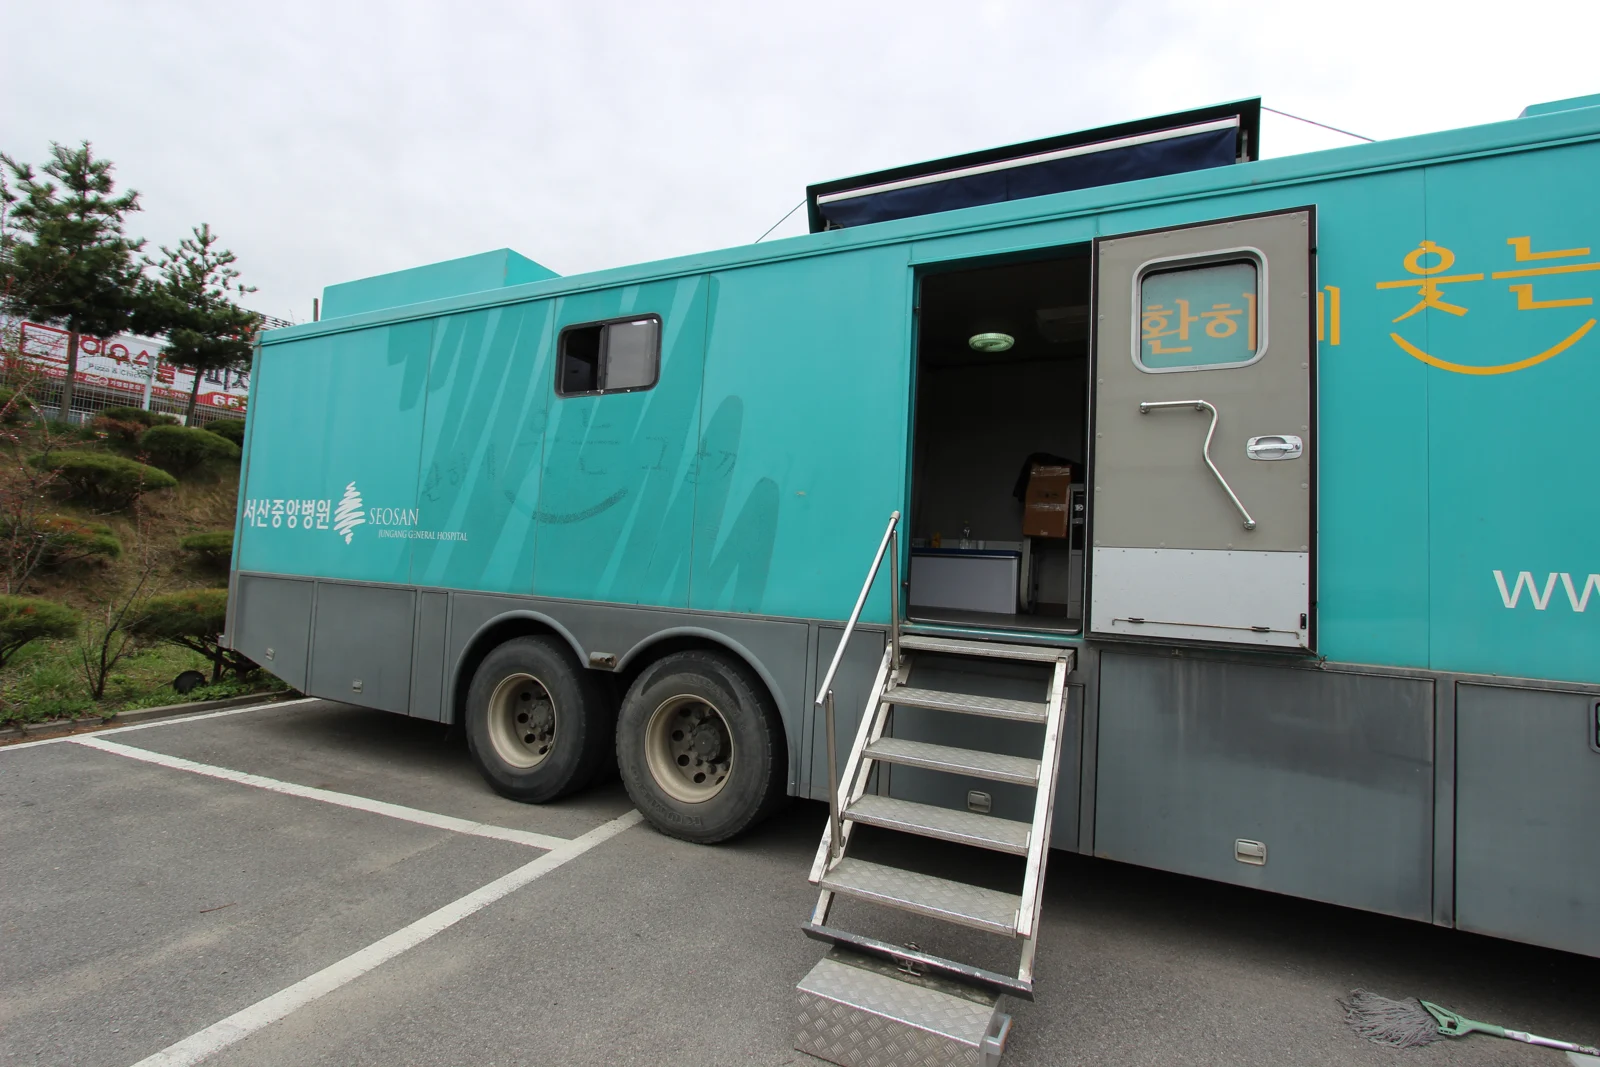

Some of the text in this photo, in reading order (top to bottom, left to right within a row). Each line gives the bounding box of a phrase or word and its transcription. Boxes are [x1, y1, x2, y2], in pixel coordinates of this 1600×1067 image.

[1375, 235, 1600, 323] 웃는
[88, 363, 110, 373] Pizza
[120, 369, 149, 380] Chicke
[243, 498, 332, 530] 서산중앙병원
[368, 507, 420, 526] SEOSAN
[378, 529, 468, 541] JUNGANG GENERAL HOSPITAL
